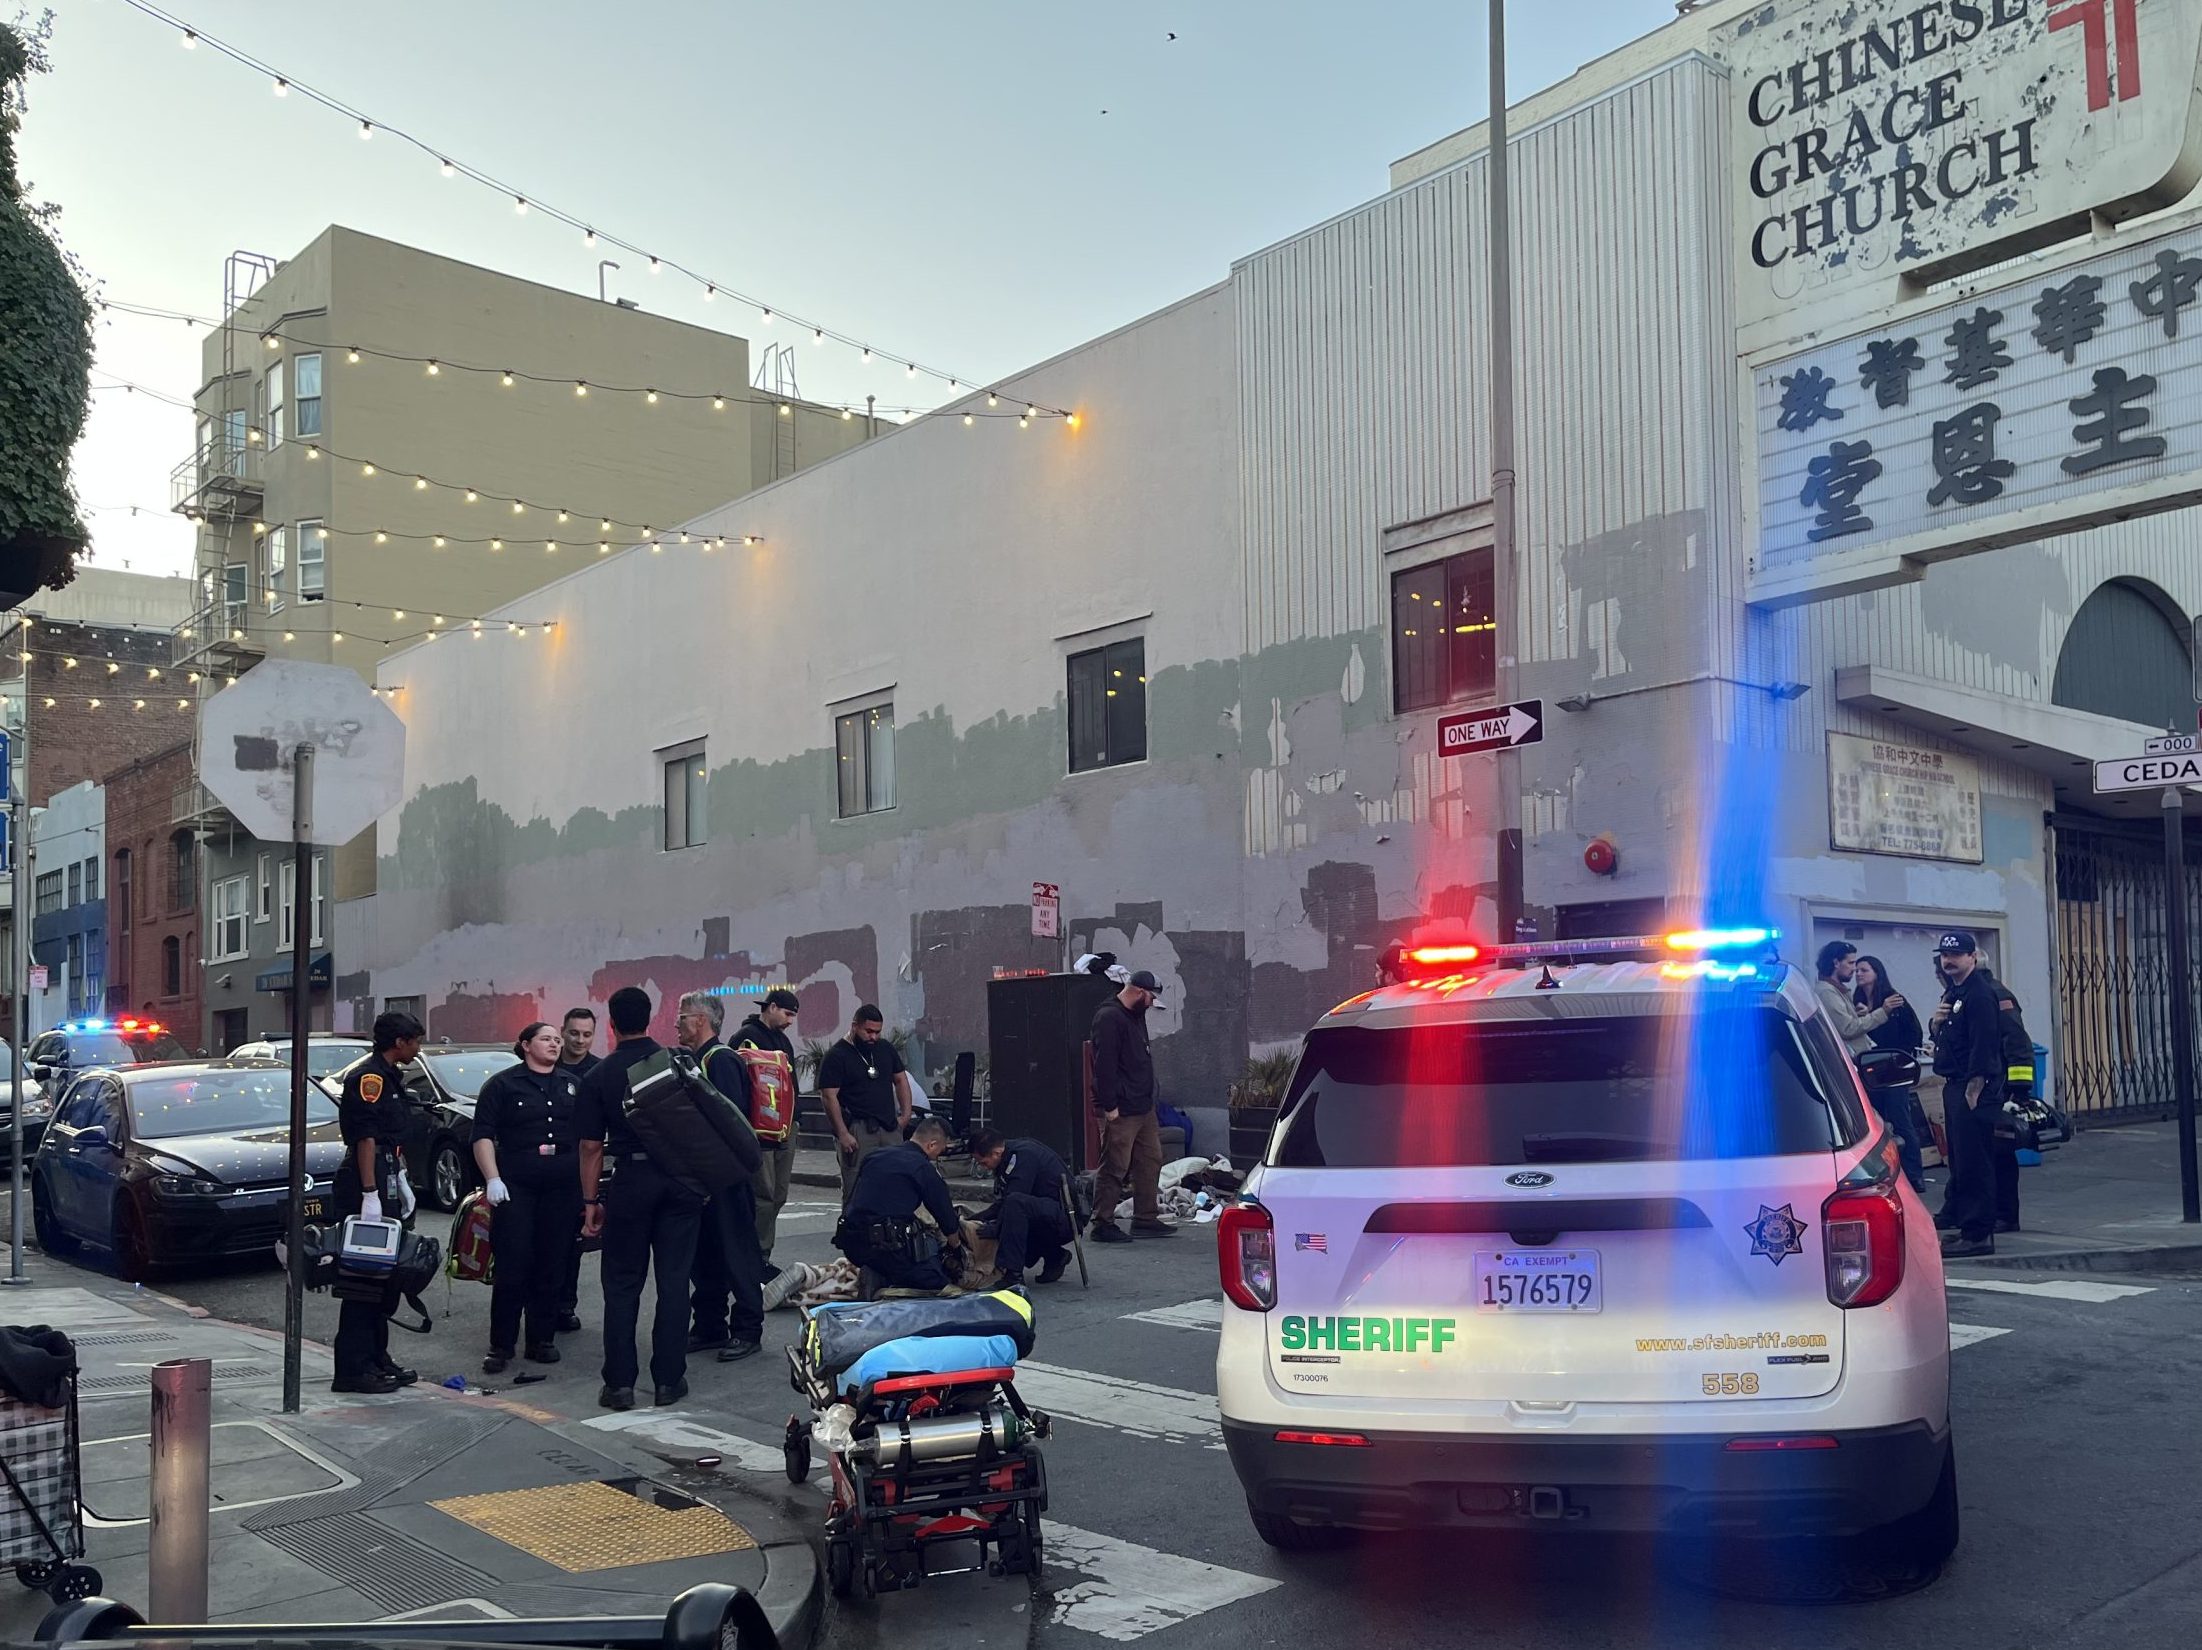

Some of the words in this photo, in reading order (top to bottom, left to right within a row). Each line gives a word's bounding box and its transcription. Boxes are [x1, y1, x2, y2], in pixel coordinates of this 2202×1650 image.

[1748, 0, 2028, 127] CHINESE
[1749, 69, 1967, 199] GRACE
[1751, 117, 2038, 268] CHURCH
[1449, 724, 1475, 743] ONE
[1481, 718, 1510, 738] WAY
[2164, 738, 2192, 750] 000
[1039, 920, 1050, 929] TIME
[1040, 910, 1050, 918] ANY
[1515, 1173, 1544, 1184] Ford
[1504, 1257, 1519, 1266] CA
[1525, 1256, 1568, 1266] EXEMPT
[1483, 1274, 1592, 1305] 1576579
[1281, 1315, 1456, 1352] SHERIFF
[1636, 1332, 1826, 1351] www.sfsheriff.com
[1702, 1373, 1760, 1395] 558
